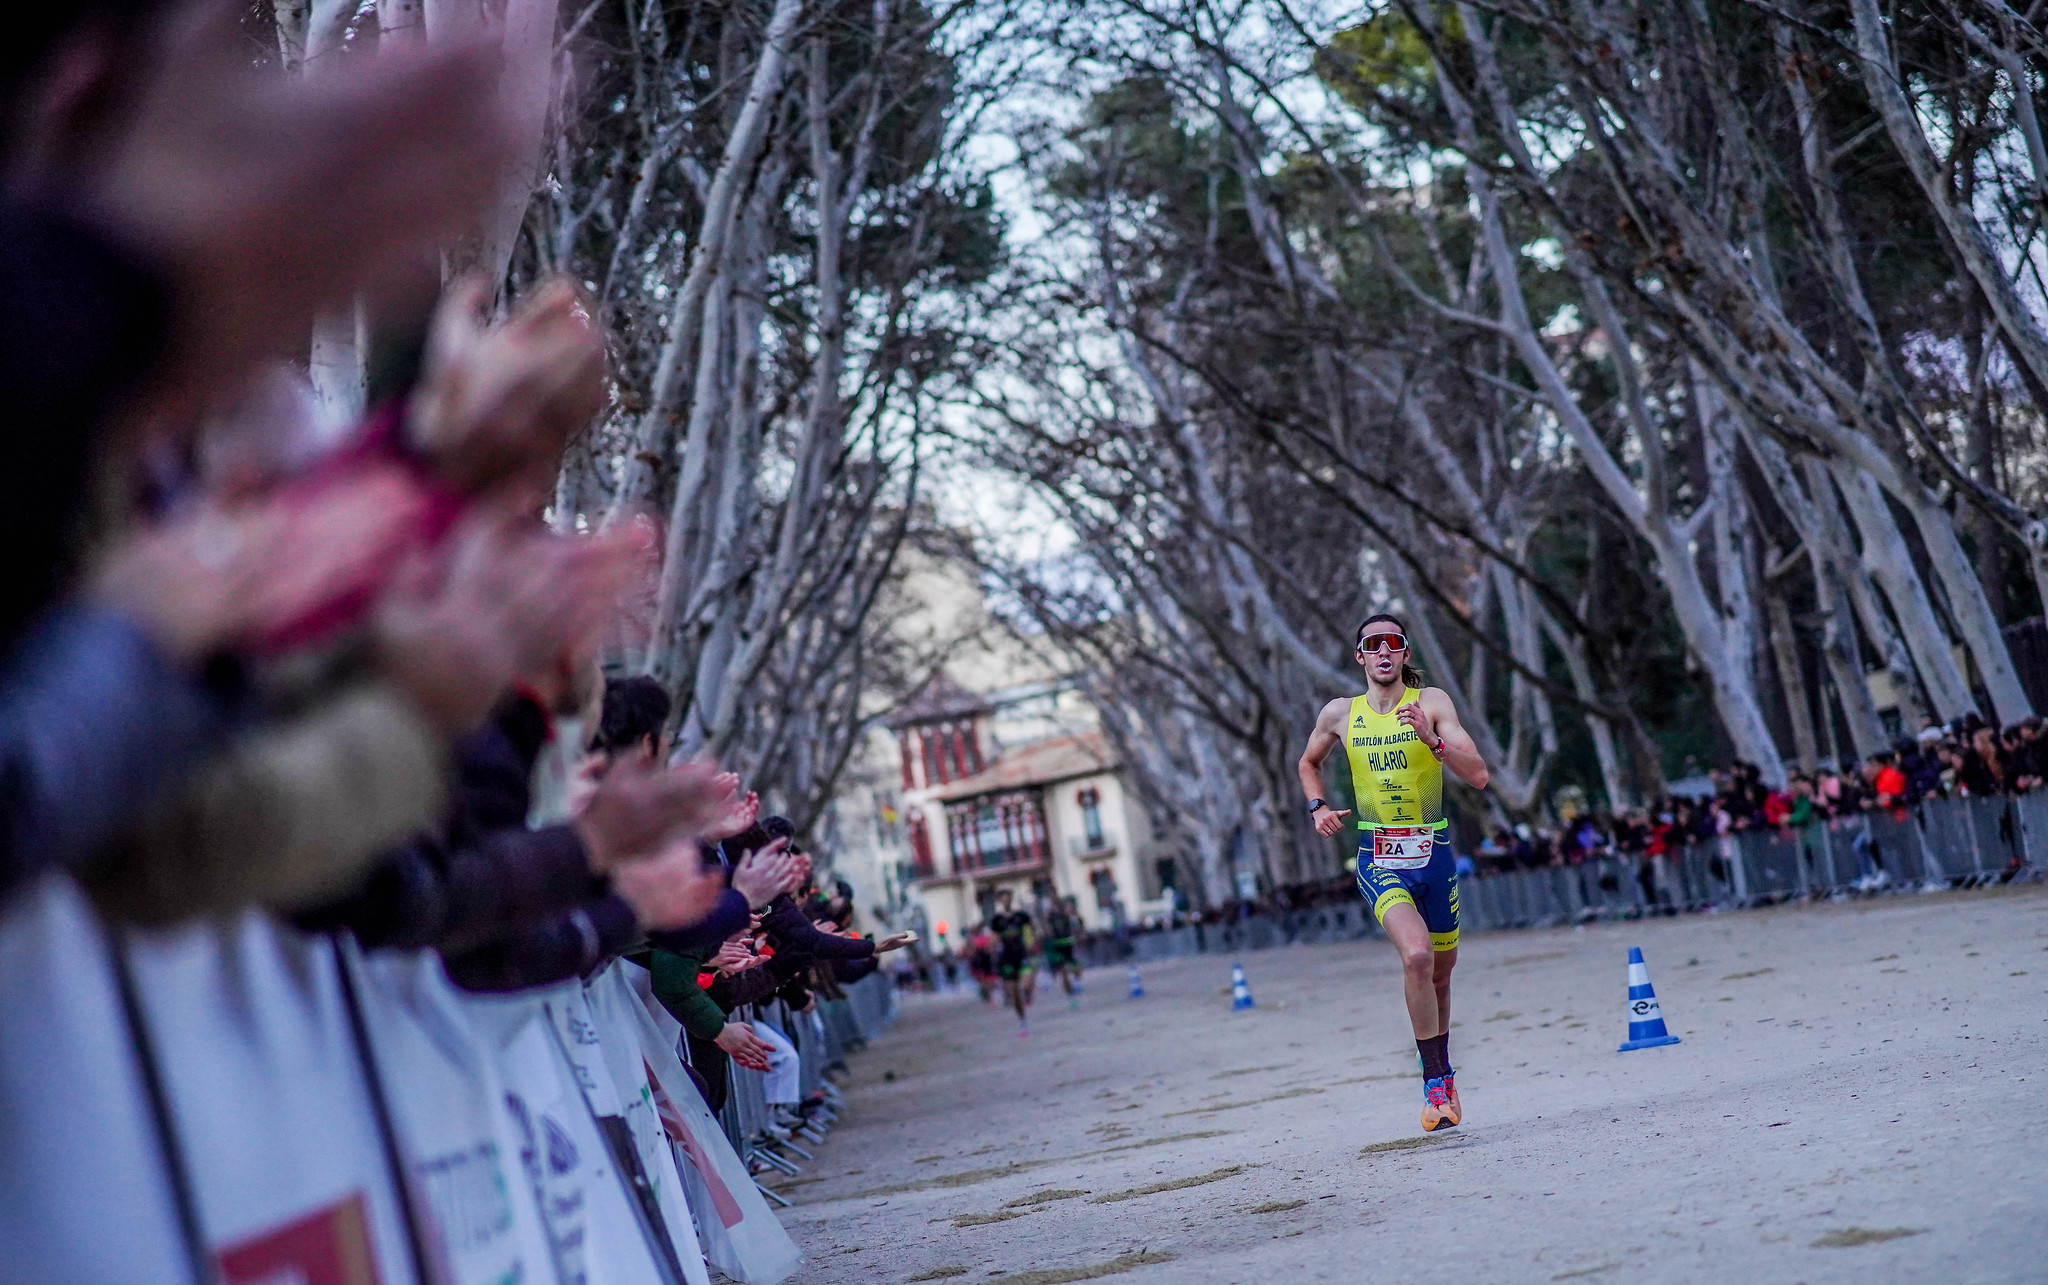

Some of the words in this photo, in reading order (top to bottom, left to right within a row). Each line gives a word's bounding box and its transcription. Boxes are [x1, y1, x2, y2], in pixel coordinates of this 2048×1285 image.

[1352, 734, 1383, 747] TRIATLÓN
[1384, 730, 1418, 745] ALBACETE
[1367, 749, 1408, 772] HILARIO
[1376, 842, 1404, 855] 12A
